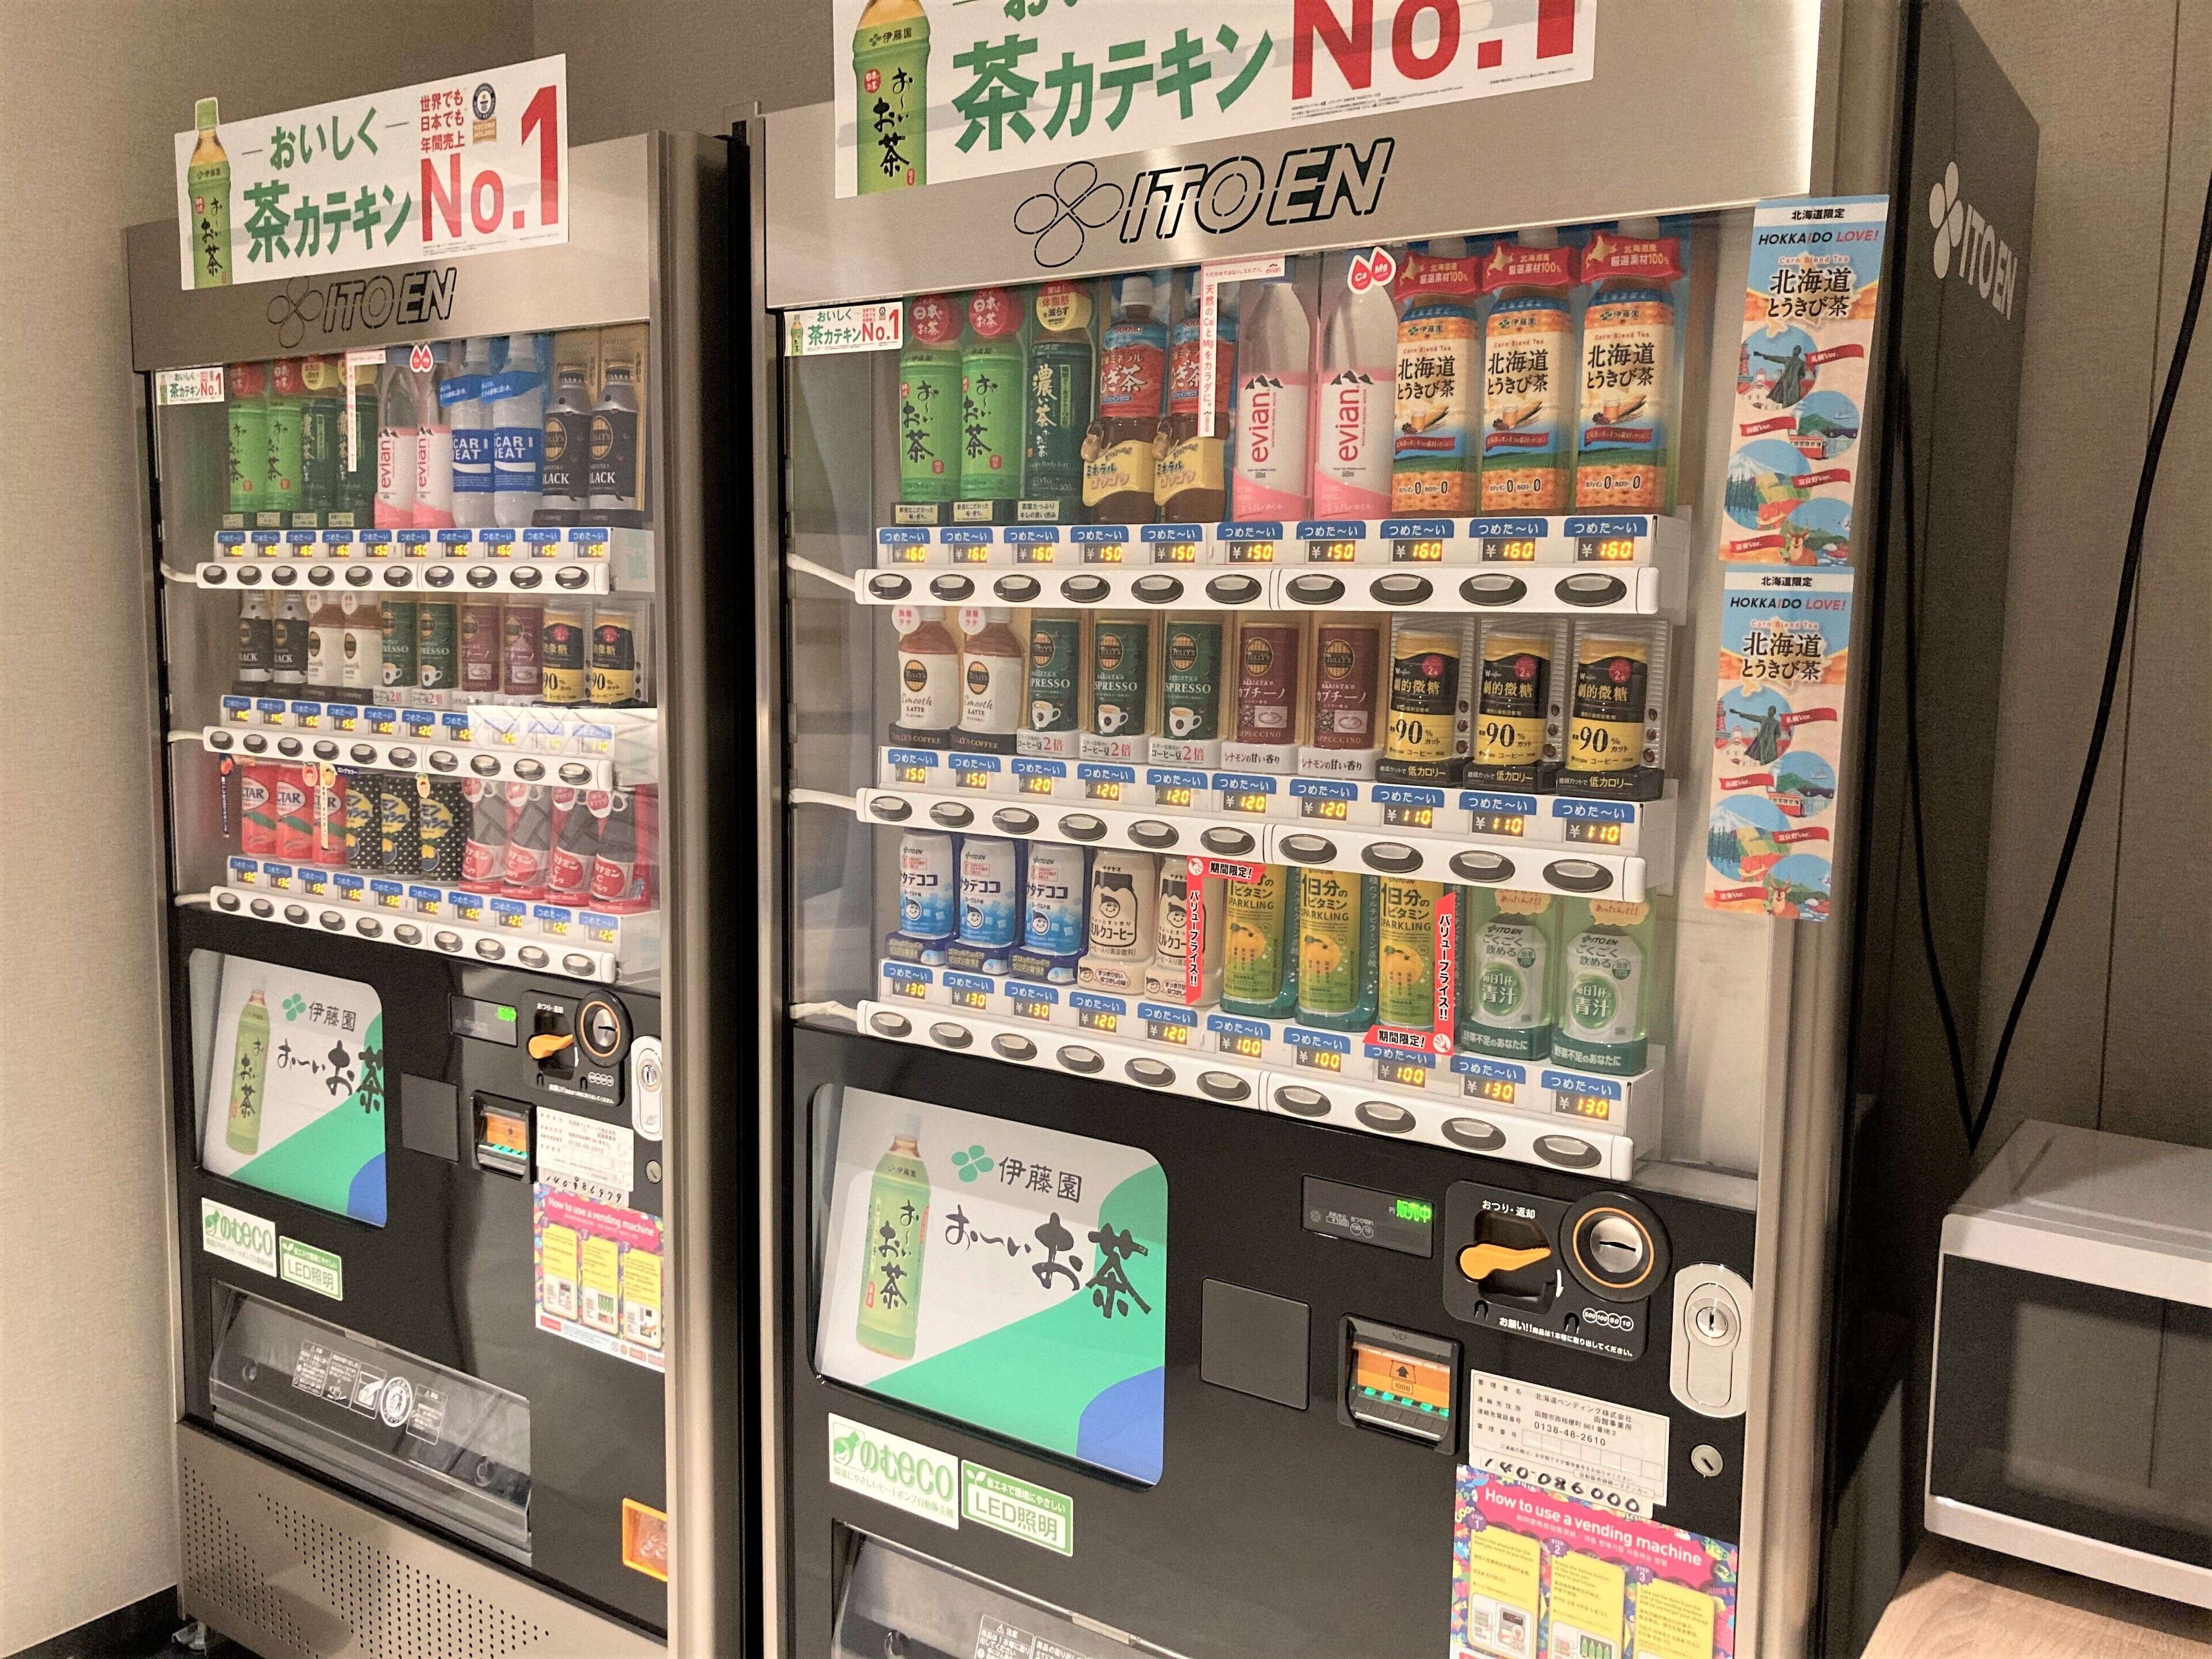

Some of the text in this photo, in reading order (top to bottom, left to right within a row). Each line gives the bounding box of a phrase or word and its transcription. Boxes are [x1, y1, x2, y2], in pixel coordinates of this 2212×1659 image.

[882, 27, 912, 43] 伊藤園
[1292, 0, 1575, 100] No.
[952, 24, 1273, 154] 茶カテキン
[421, 89, 464, 112] 世界でも
[421, 110, 464, 131] 日本でも
[270, 108, 378, 171] おいしく
[421, 131, 465, 153] 年間売上
[421, 85, 558, 242] No.1
[244, 180, 412, 264] 茶カテキン
[1791, 209, 1845, 221] 北海道限定
[1758, 230, 1879, 245] HOKKAIDO LOVE!
[1374, 263, 1388, 274] Mg
[1770, 268, 1851, 294] 北海道
[817, 308, 853, 323] おいしく
[1767, 296, 1849, 317] とうきび茶
[808, 324, 861, 346] 茶カテキン
[862, 309, 899, 342] No.1
[1419, 324, 1444, 334] 伊藤園
[1488, 349, 1548, 375] 北海道
[1588, 343, 1654, 368] 北海道
[1398, 356, 1455, 381] 北海道
[1587, 368, 1654, 389] とうきび茶
[170, 382, 200, 398] 茶カテキン
[200, 373, 223, 396] No.1
[1397, 381, 1454, 400] とうきび茶
[1488, 375, 1548, 395] とうきび茶
[1252, 392, 1270, 463] evian
[1339, 389, 1360, 462] evian
[381, 440, 391, 488] evian
[418, 438, 426, 487] evian
[1762, 577, 1812, 587] 北海道限定
[1730, 597, 1846, 611] HOKKAIDO LOVE!
[1743, 632, 1822, 658] 北海道
[1741, 659, 1821, 680] とうきび茶
[1393, 680, 1440, 695] 劇的微糖
[1483, 680, 1533, 698] 劇的微糖
[1578, 684, 1627, 702] 劇的微糖
[902, 694, 932, 706] Smooth
[964, 695, 993, 709] Smooth
[971, 739, 998, 748] COFFEE
[1210, 862, 1252, 880] 期間限定!
[1308, 897, 1347, 910] ビタミン
[1388, 908, 1429, 920] ビタミン
[1090, 923, 1133, 940] ミルクコーヒー
[1190, 891, 1198, 986] バリュープライス!!
[1483, 934, 1522, 946] ごくごく
[1487, 945, 1516, 957] 飲める
[1577, 945, 1618, 958] ごくごく
[1440, 915, 1450, 1020] バリュープライス!!
[1580, 956, 1611, 968] 飲める
[1482, 986, 1516, 1005] 青汁
[309, 1001, 356, 1032] 伊藤園
[1576, 998, 1609, 1017] 青汁
[1379, 1030, 1425, 1047] 期間限定!
[999, 1155, 1082, 1204] 伊藤園
[548, 1198, 564, 1211] How
[565, 1202, 573, 1212] to
[573, 1207, 586, 1218] use
[593, 1212, 621, 1230] vending
[623, 1220, 654, 1237] machine
[1396, 1200, 1432, 1223] 販売中
[1482, 1200, 1535, 1219] おつり・返却
[221, 1215, 272, 1257] のむeco
[288, 1257, 334, 1290] LED照明
[1396, 1382, 1410, 1391] 1000
[1534, 1422, 1605, 1446] 0138-48-2610
[861, 1438, 955, 1503] のむeco
[834, 1465, 954, 1519] 環境にやさしいヒートポンプ自動販売機
[987, 1477, 1065, 1514] 省エネで環境にやさしい
[976, 1492, 1058, 1542] LED照明
[1485, 1488, 1516, 1513] How
[1519, 1501, 1533, 1514] to
[1535, 1507, 1561, 1523] use
[1563, 1517, 1573, 1526] a
[1575, 1520, 1633, 1548] vending
[1636, 1535, 1702, 1566] machine
